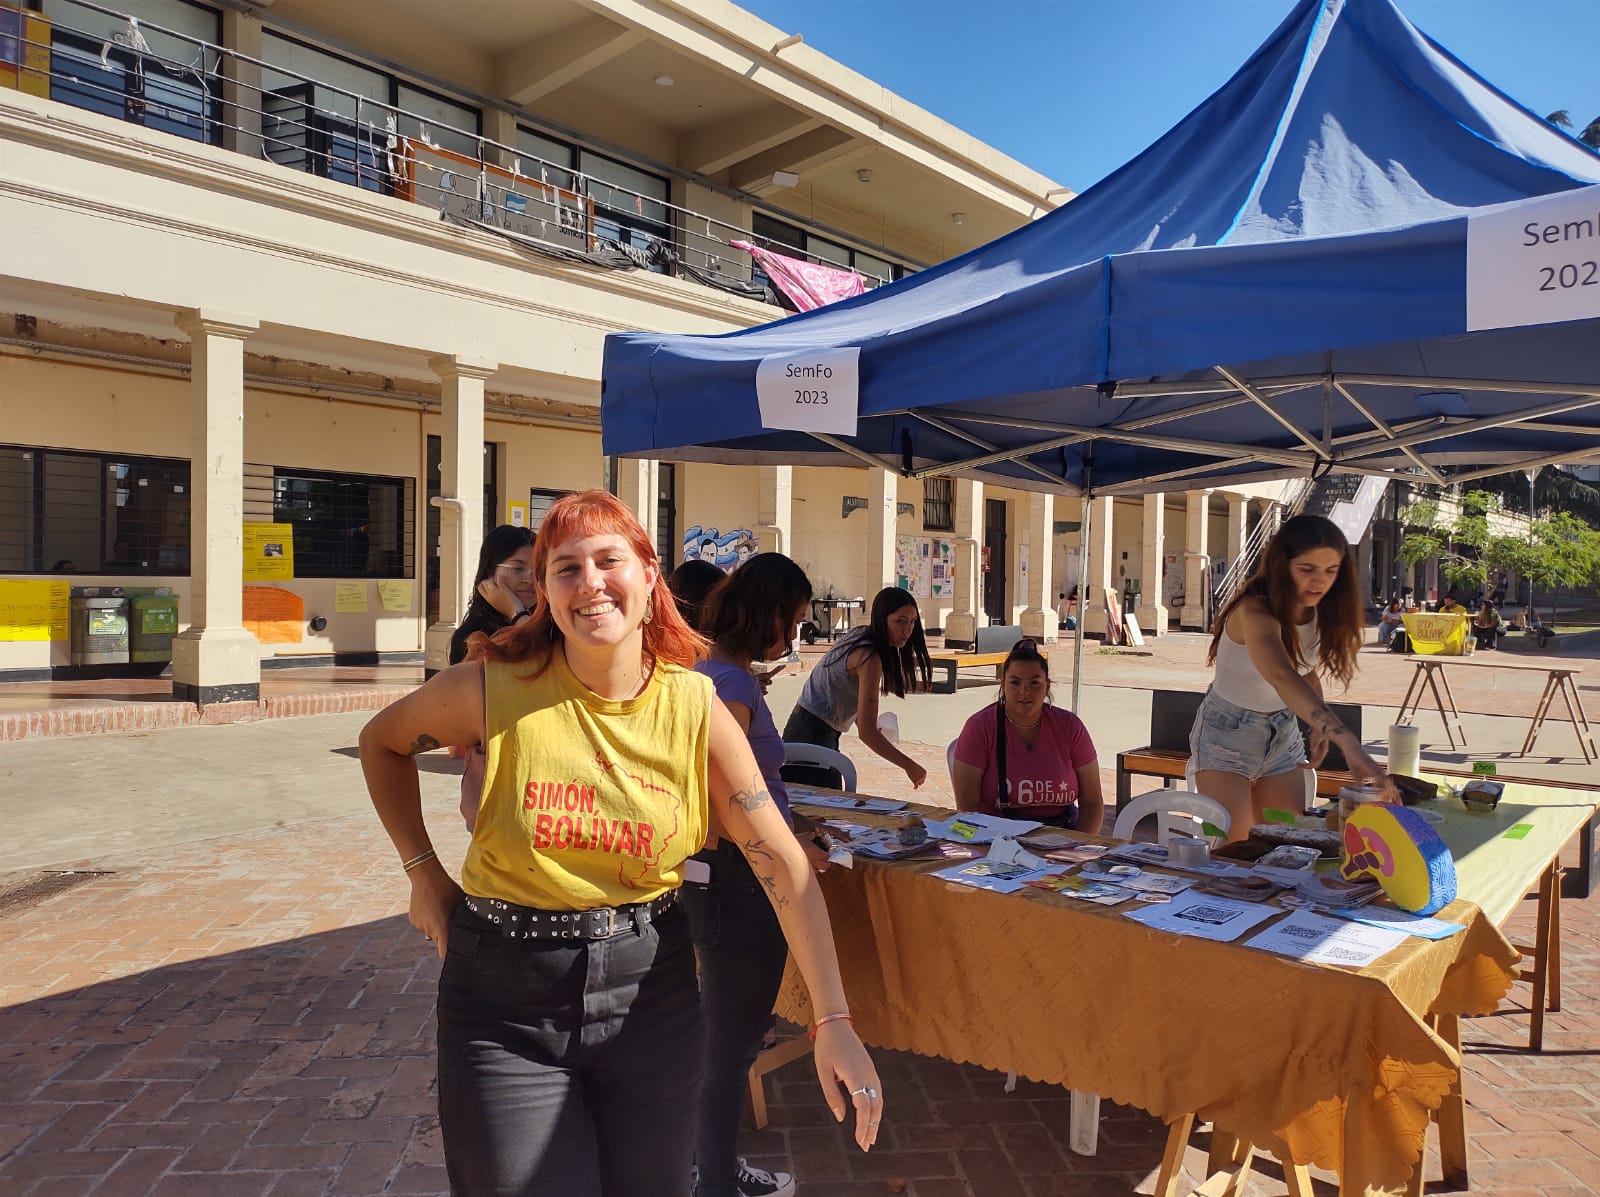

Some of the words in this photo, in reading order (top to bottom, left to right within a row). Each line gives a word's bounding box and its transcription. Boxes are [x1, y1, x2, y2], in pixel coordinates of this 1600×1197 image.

[1523, 212, 1600, 247] Sem
[785, 363, 833, 379] SemFo
[794, 389, 829, 405] 2023
[1035, 780, 1054, 793] DE
[524, 778, 596, 814] SIMÓN
[1034, 790, 1076, 803] JUNIO
[533, 809, 655, 859] BOLÍVAR
